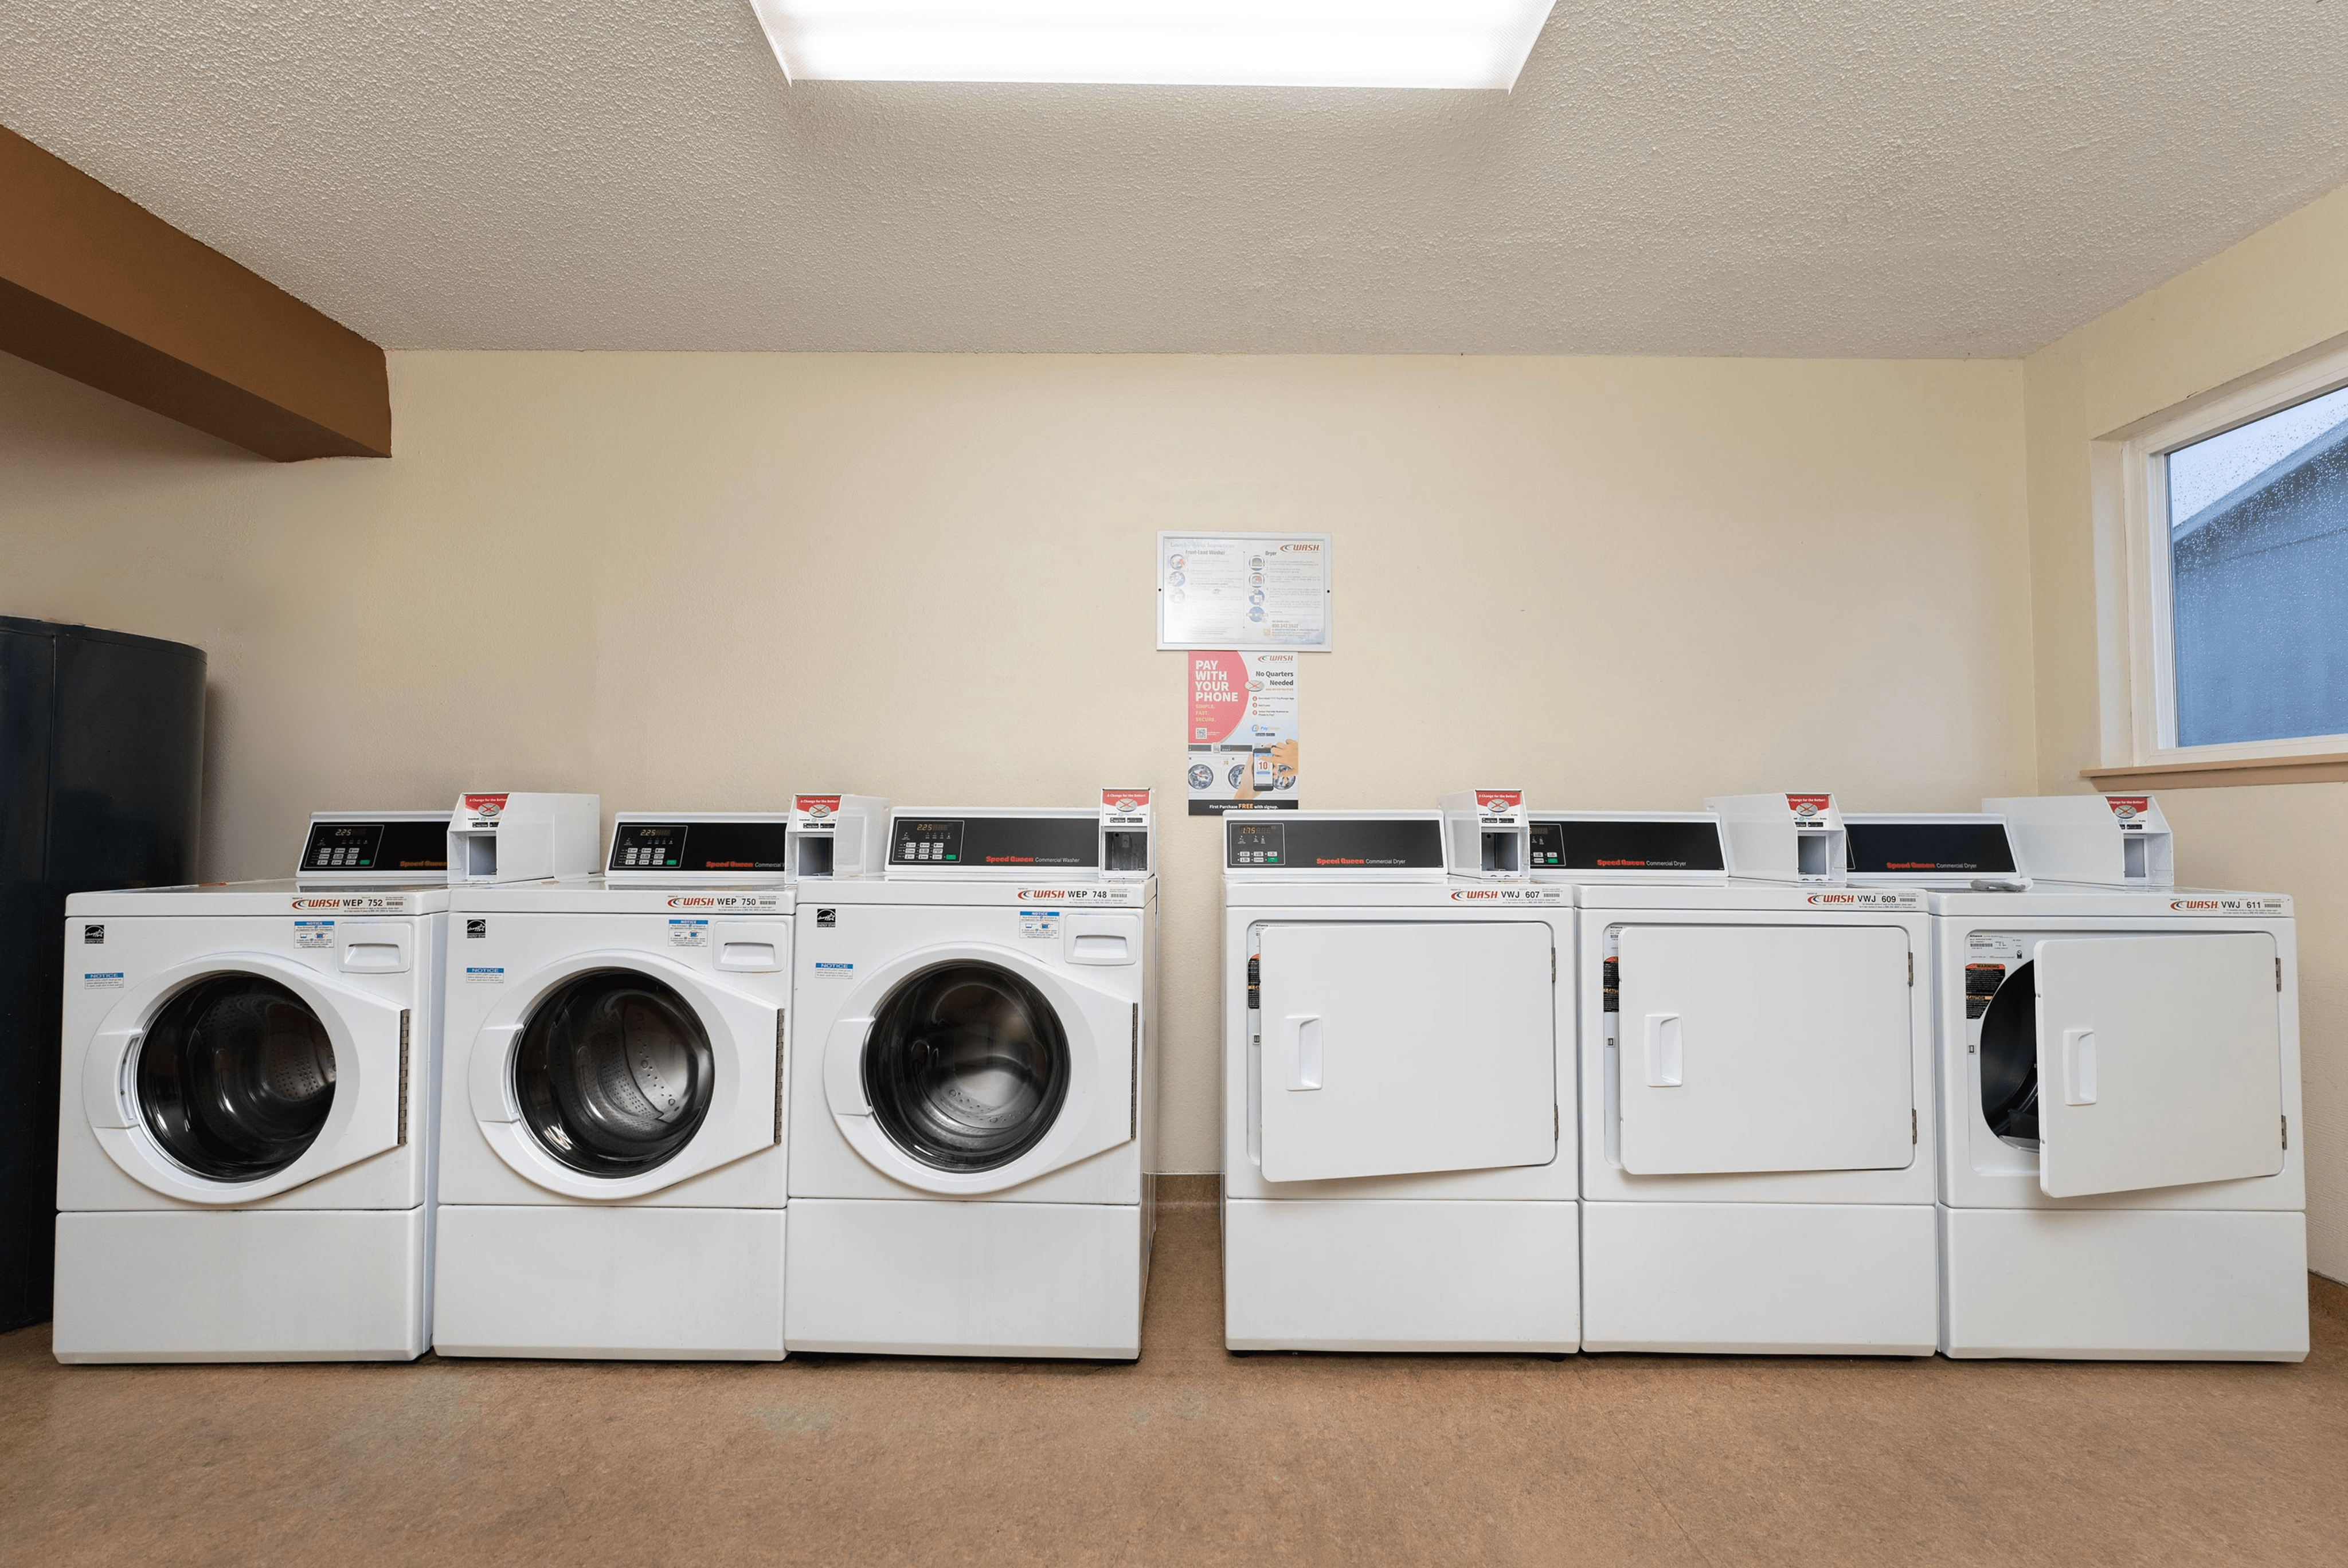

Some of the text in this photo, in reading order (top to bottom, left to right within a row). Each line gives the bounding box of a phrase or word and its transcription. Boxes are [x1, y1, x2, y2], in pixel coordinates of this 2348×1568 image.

[1195, 660, 1218, 670] PAY
[1195, 671, 1227, 681] WITH
[1195, 681, 1229, 691] YOUR
[1195, 692, 1238, 702] PHONE
[1258, 762, 1267, 770] 10
[1033, 890, 1065, 898] WASH
[1466, 891, 1498, 899] WASH
[308, 899, 340, 907] WASH
[683, 897, 714, 905] WASH
[1823, 895, 1854, 903] WASH
[2186, 900, 2218, 908] WASH
